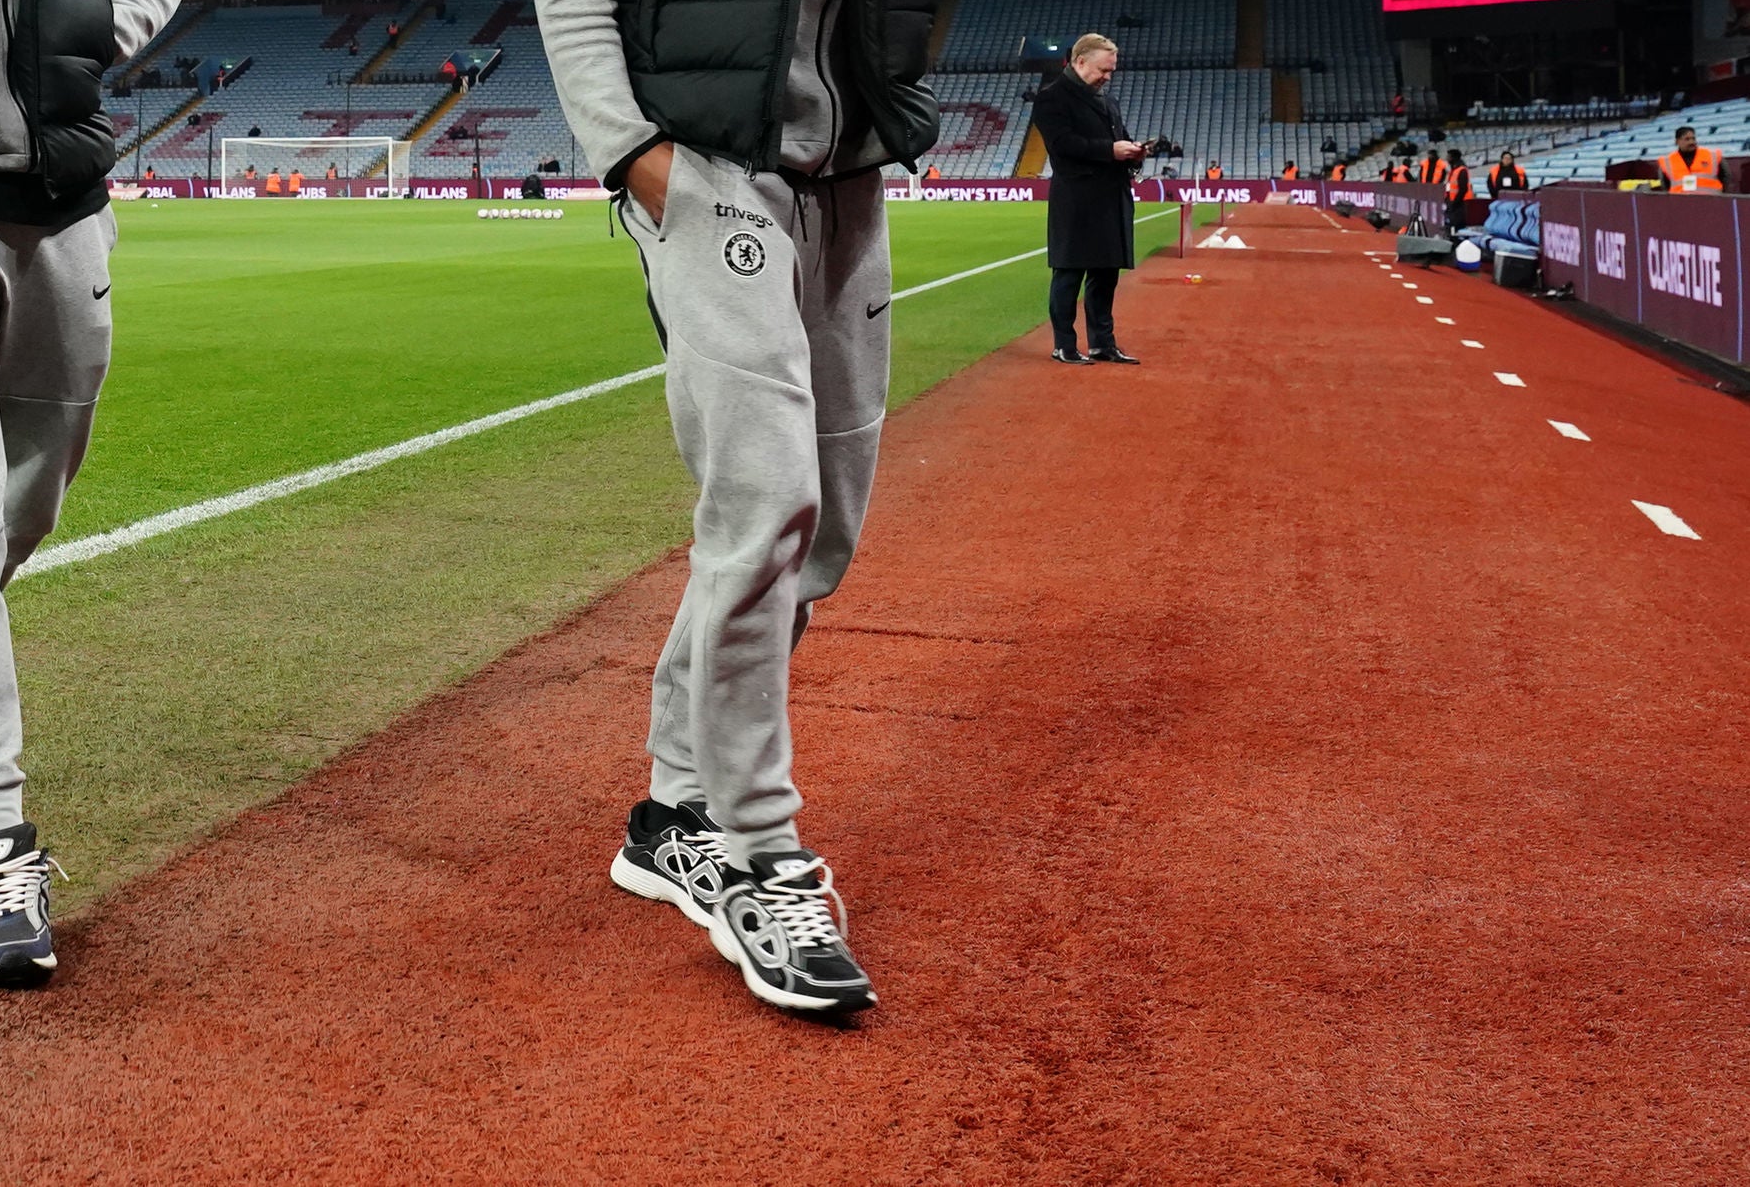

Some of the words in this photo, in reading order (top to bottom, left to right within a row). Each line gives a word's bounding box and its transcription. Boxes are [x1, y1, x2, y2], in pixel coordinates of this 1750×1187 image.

[203, 187, 256, 199] VILLANS
[412, 187, 468, 199] VILLANS
[987, 187, 1033, 201] TEAM
[1178, 188, 1250, 202] VILLANS
[714, 201, 773, 228] trivago
[1595, 228, 1626, 280] CLARET
[1647, 236, 1692, 299] CLARET
[1691, 243, 1723, 308] LITE
